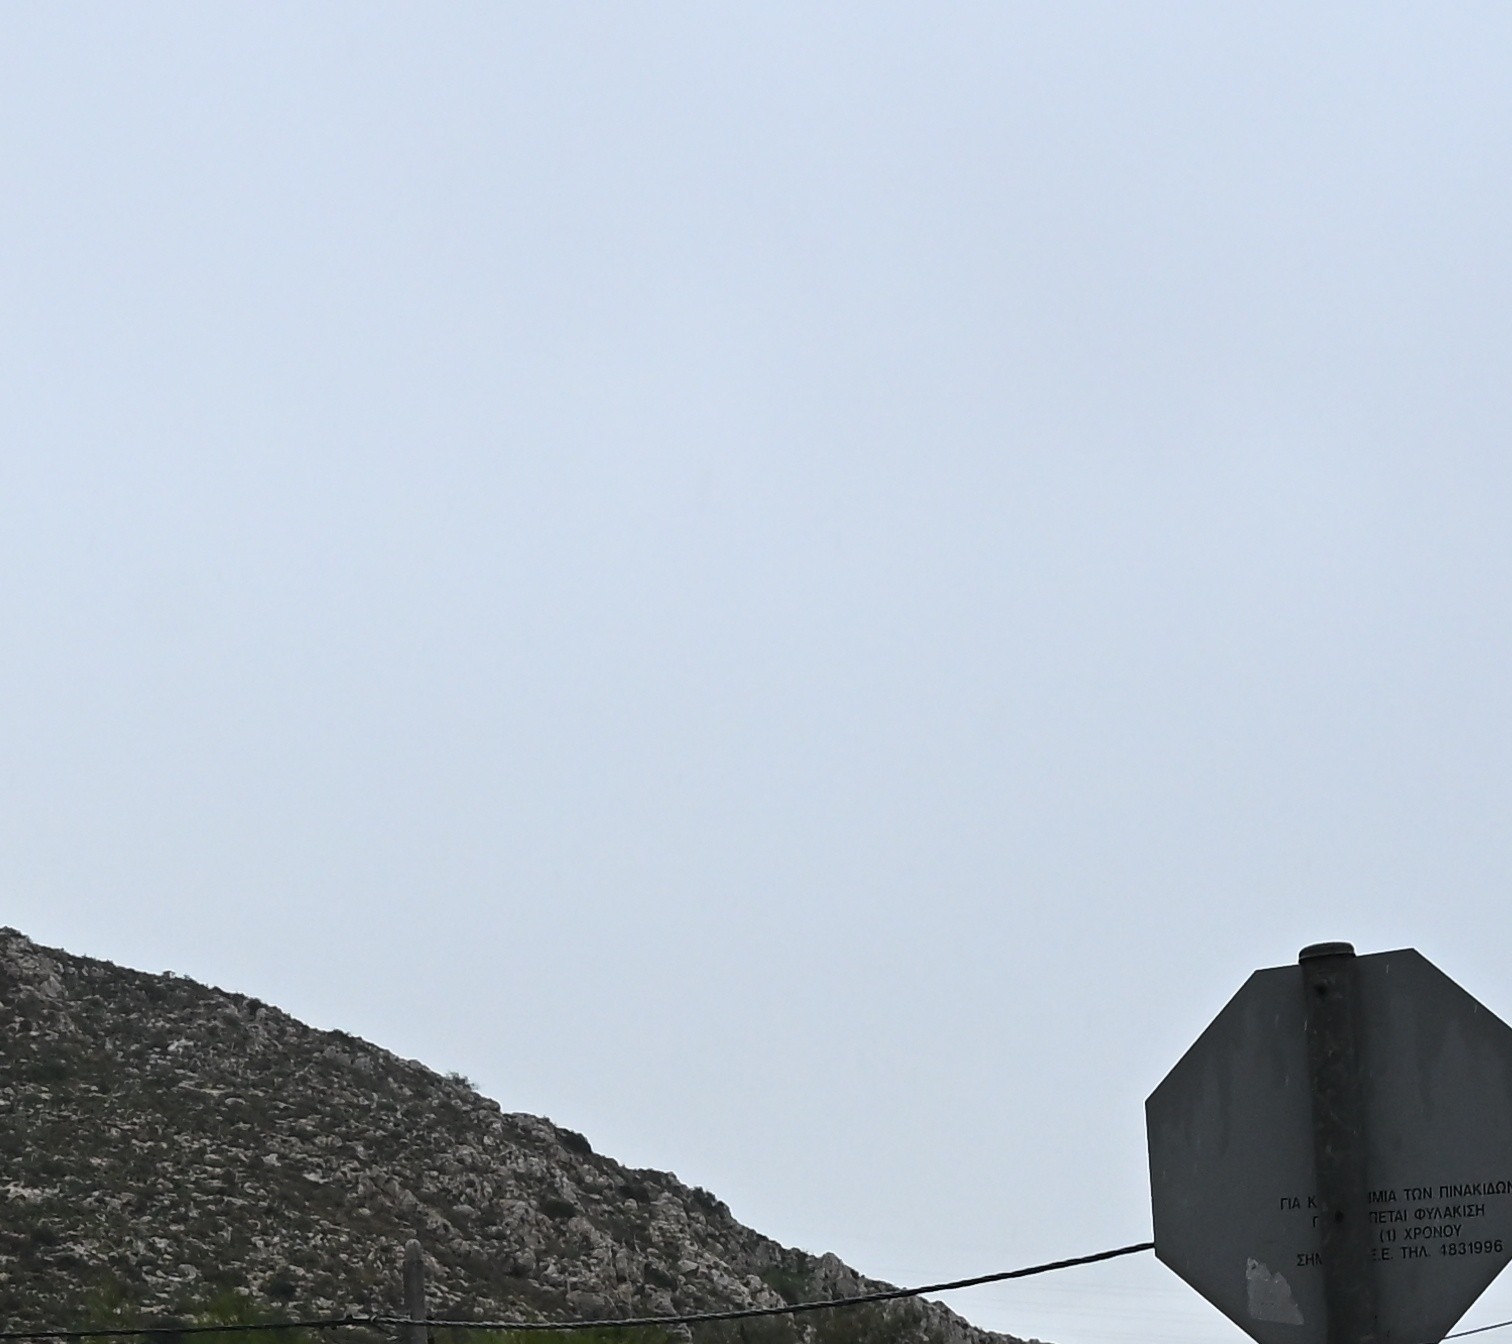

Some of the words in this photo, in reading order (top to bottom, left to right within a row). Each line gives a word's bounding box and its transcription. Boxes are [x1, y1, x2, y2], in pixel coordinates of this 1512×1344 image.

[1280, 1197, 1300, 1210] ΓΙΑ
[1404, 1187, 1432, 1200] ΤΩΝ
[1414, 1204, 1485, 1220] ΦΥΛΑΚΙΣΗ
[1404, 1224, 1462, 1240] ΧΡΟΝΟΥ
